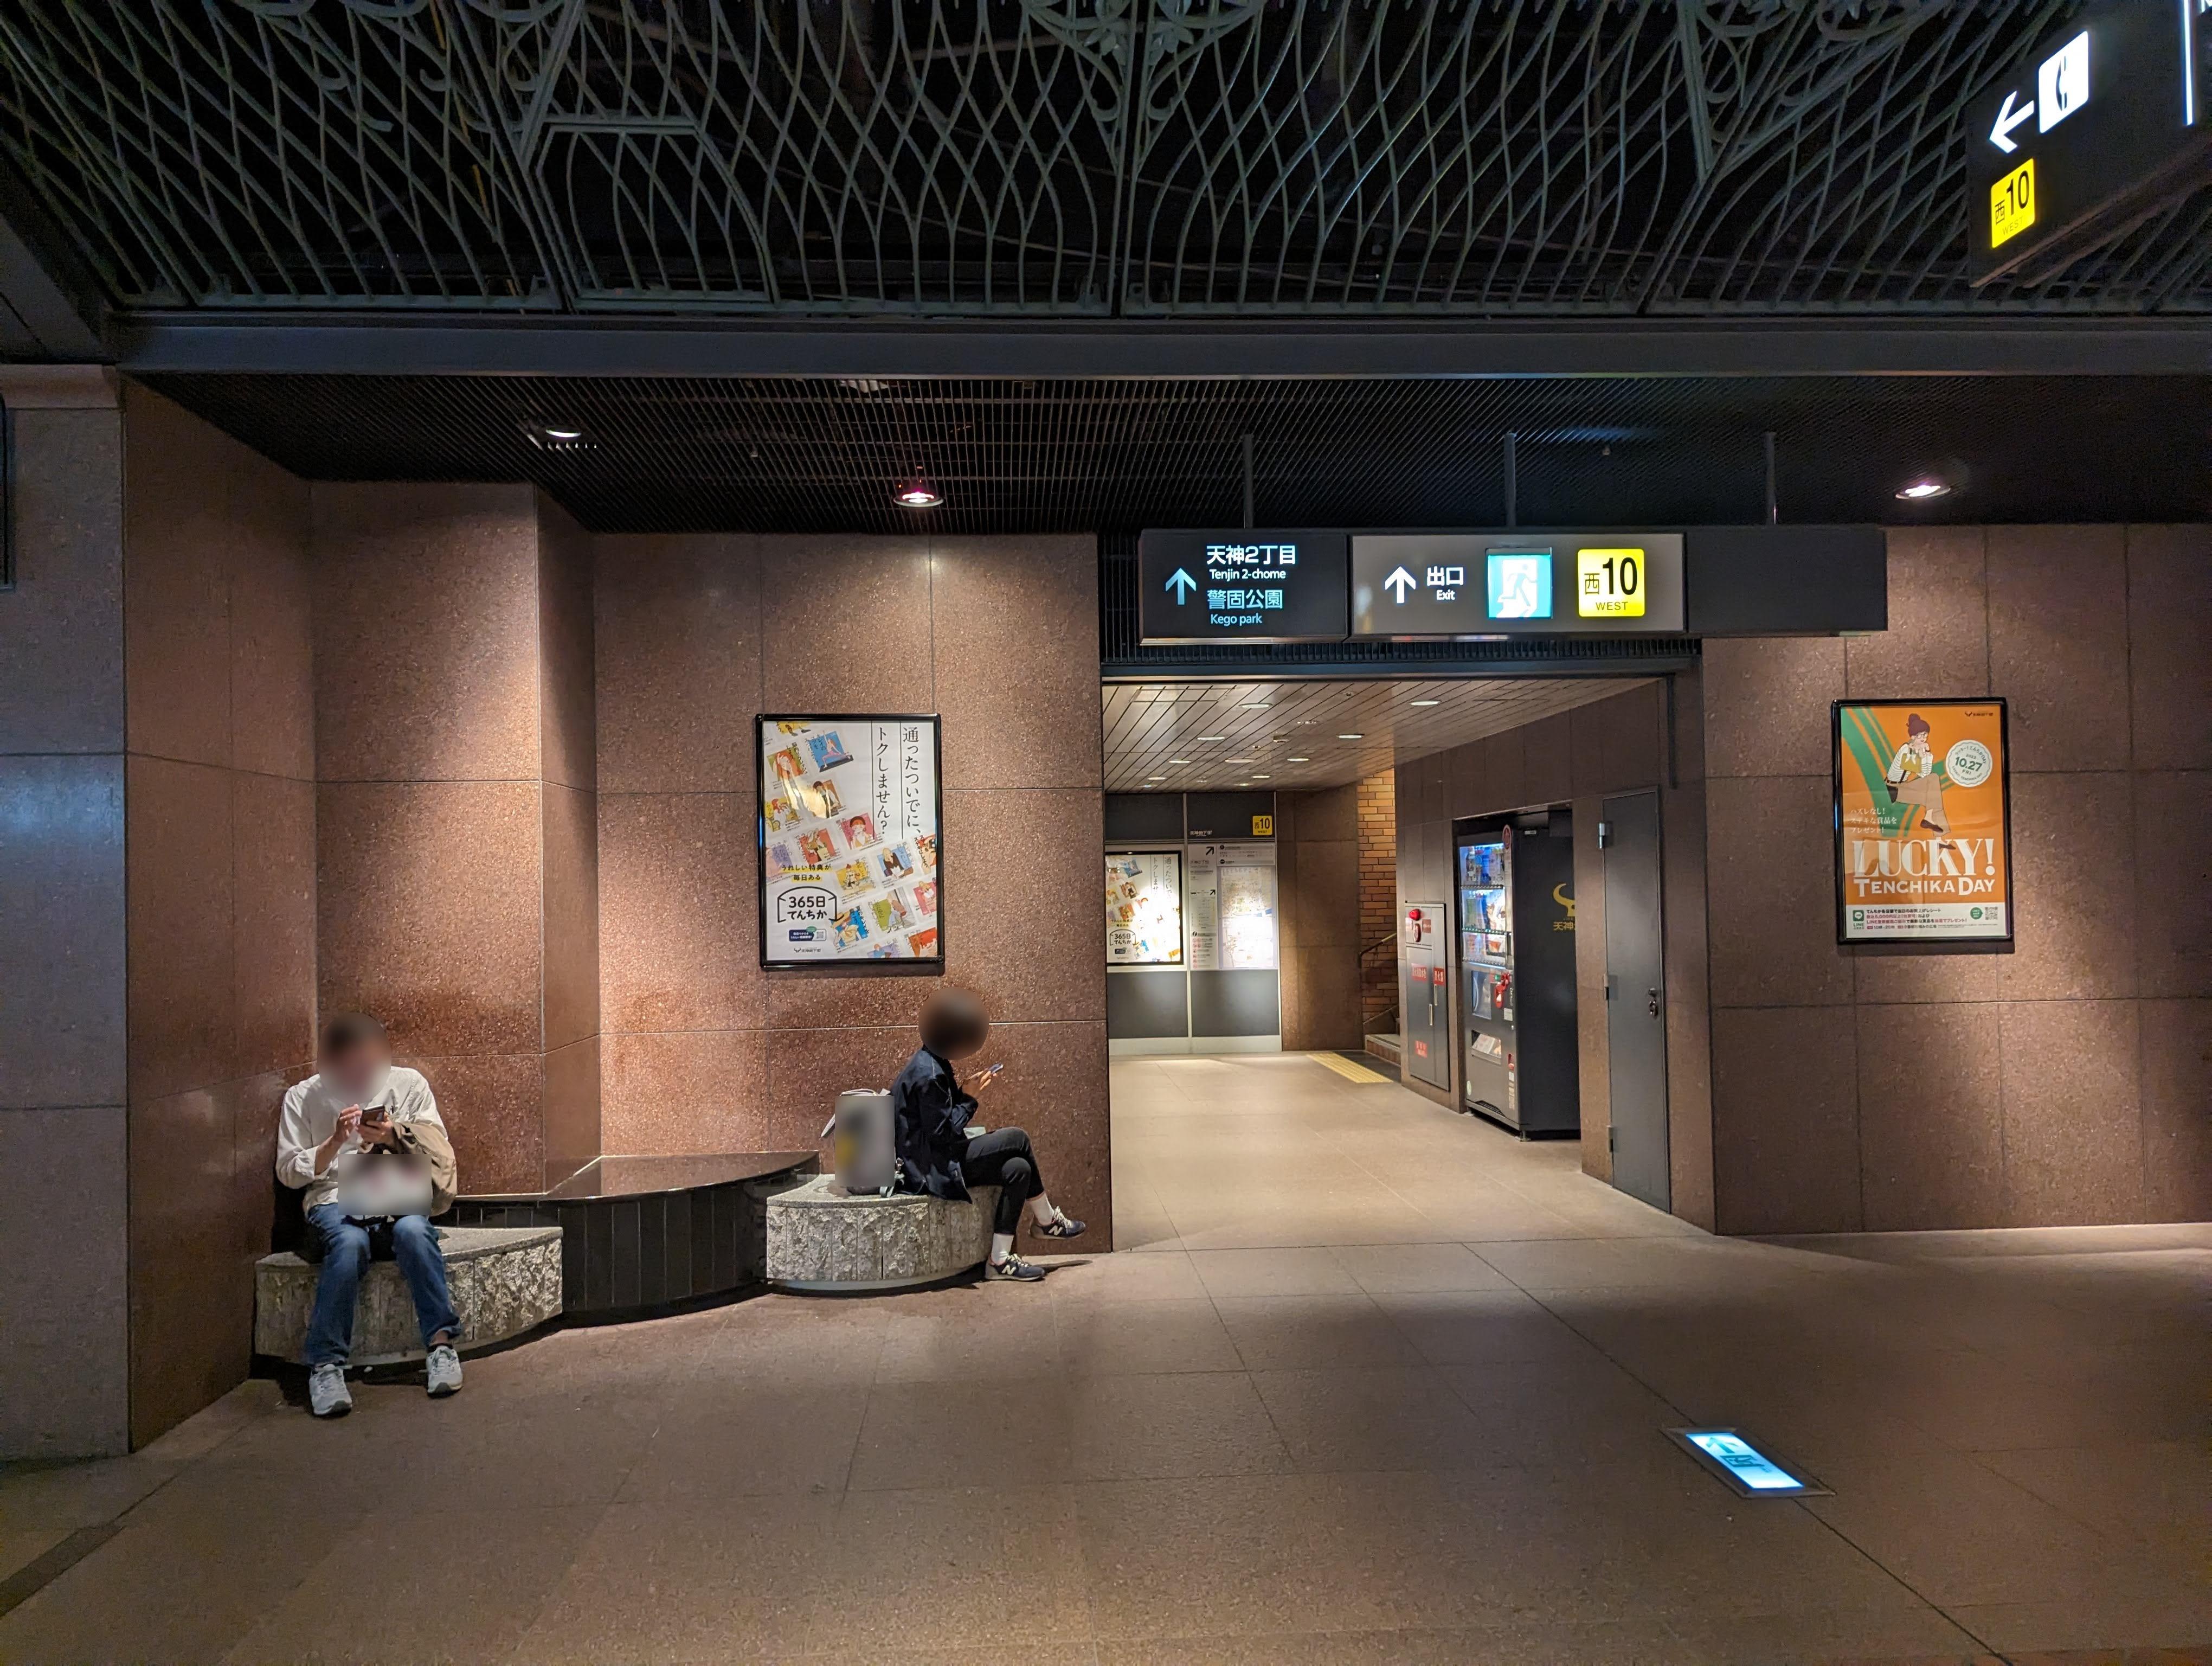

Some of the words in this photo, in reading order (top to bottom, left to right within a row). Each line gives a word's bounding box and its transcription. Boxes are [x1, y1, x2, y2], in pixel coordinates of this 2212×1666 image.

[2002, 216, 2023, 235] WEST
[1206, 544, 1295, 565] 天神2丁目
[1209, 568, 1240, 582] Tenjin
[1242, 568, 1286, 579] 2-chome
[1426, 566, 1464, 586] 出口
[1207, 589, 1283, 610] 警固公園
[1436, 589, 1456, 600] Exit
[1596, 601, 1629, 611] WEST
[1210, 613, 1237, 626] Kego
[1239, 612, 1262, 626] park
[1955, 757, 1983, 772] 10.27
[1852, 838, 1996, 877] LUCKY!
[1853, 877, 1956, 897] TENCHIKA
[1958, 877, 1996, 895] DAY
[788, 896, 826, 908] 365日
[787, 909, 827, 920] てんちか
[1553, 921, 1576, 931] 天神
